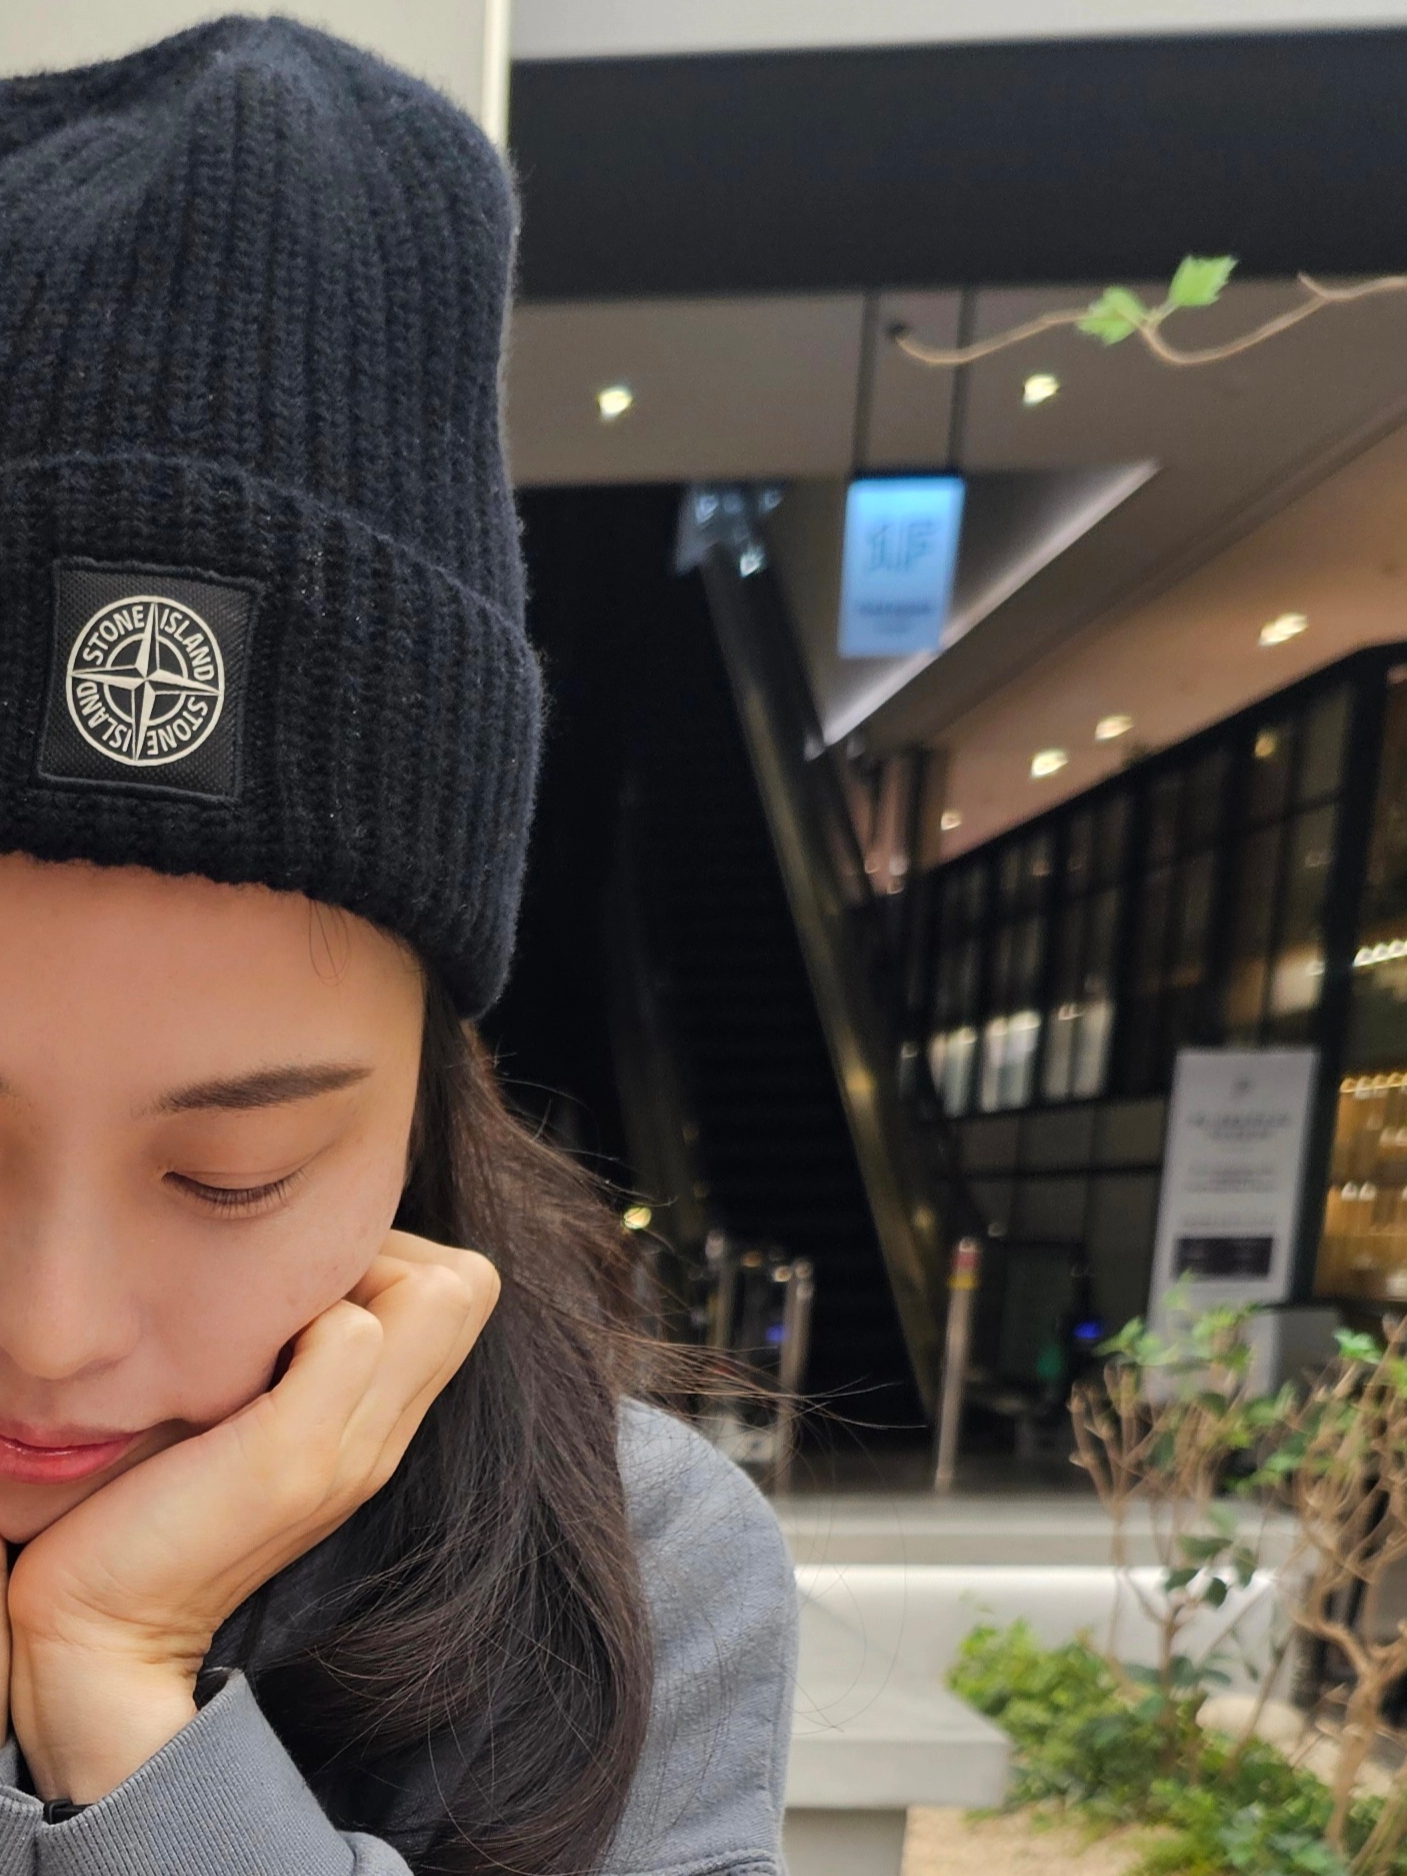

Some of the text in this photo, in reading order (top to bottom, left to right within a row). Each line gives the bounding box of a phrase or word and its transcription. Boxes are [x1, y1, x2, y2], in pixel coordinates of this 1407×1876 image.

[82, 605, 215, 681] STONE ISLAND
[76, 681, 209, 756] STONE ISLAND
